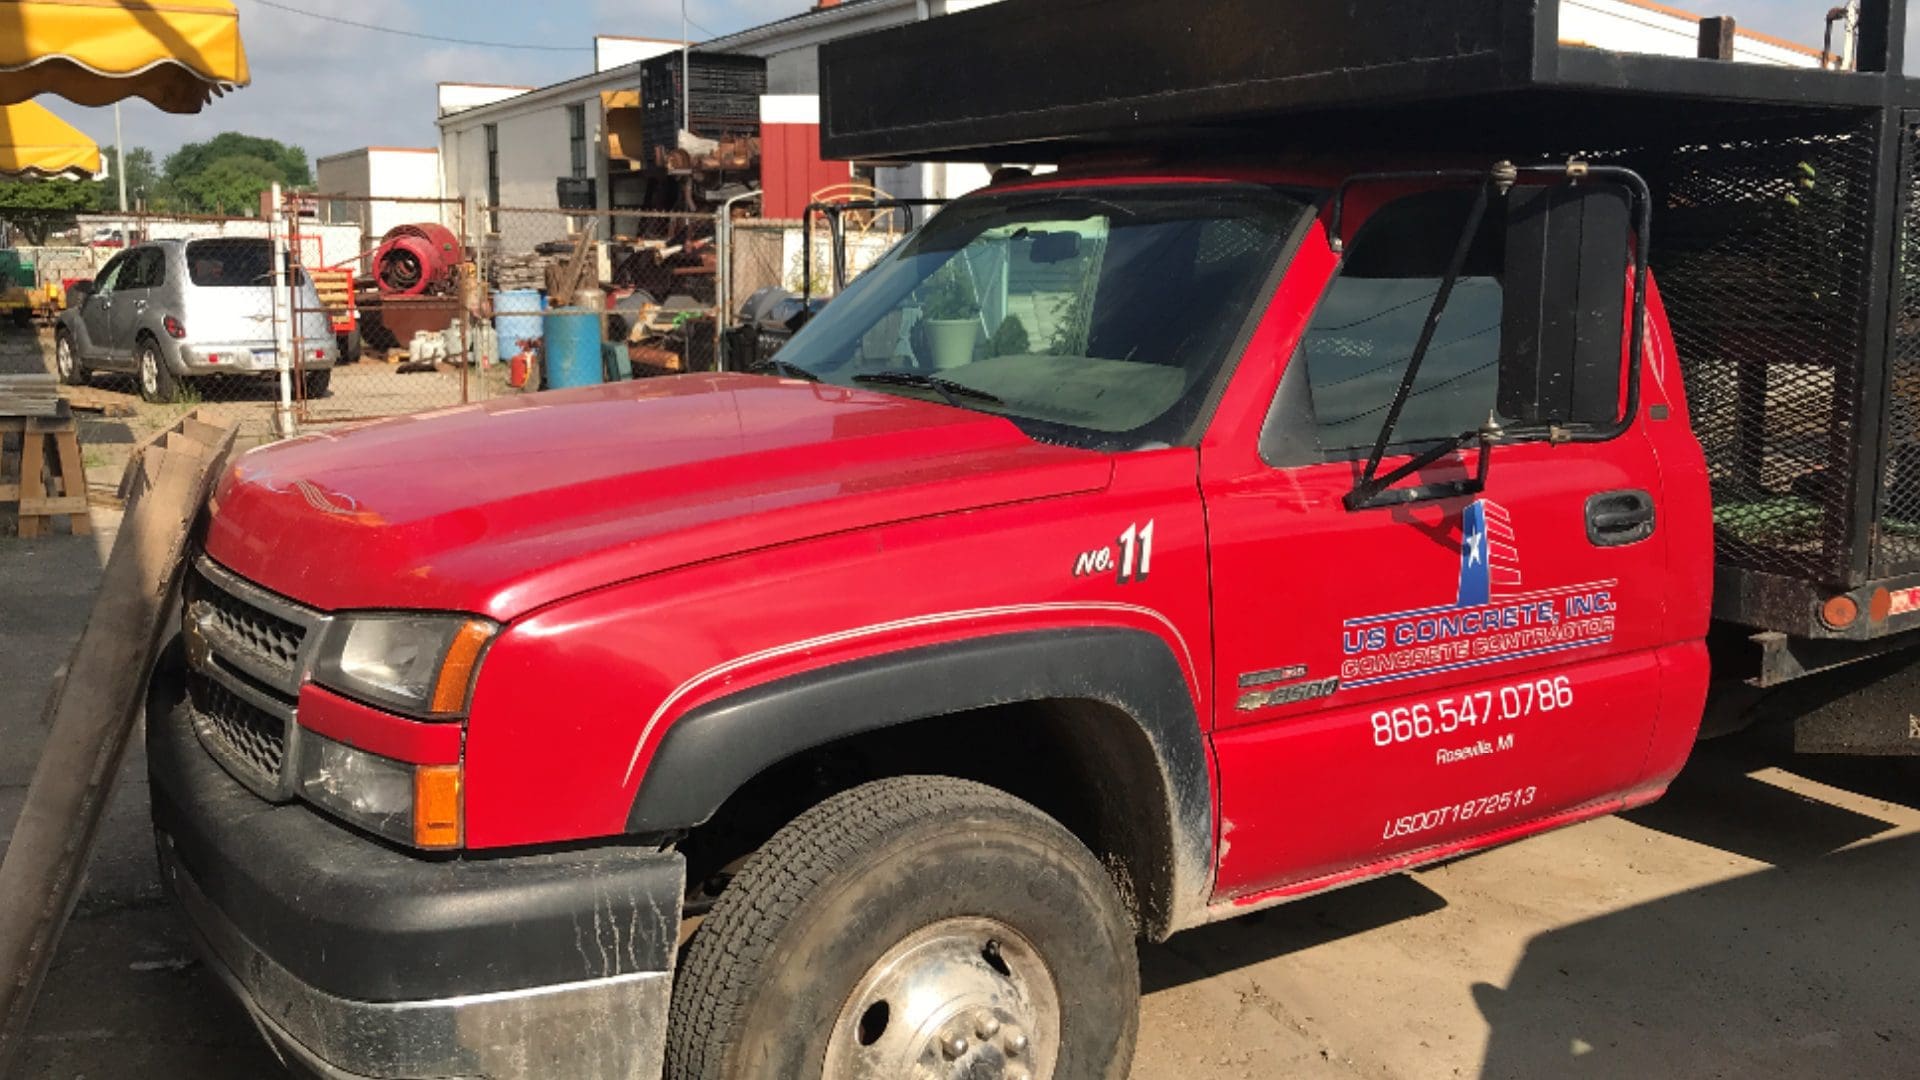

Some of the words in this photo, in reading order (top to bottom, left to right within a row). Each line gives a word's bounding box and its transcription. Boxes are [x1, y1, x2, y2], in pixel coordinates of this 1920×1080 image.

[1116, 518, 1154, 585] 11
[1341, 639, 1470, 678] CONCRETE
[1472, 616, 1615, 656] CONTRACTOR
[1343, 626, 1386, 654] US
[1394, 601, 1559, 646] CONCRETE,
[1565, 591, 1617, 618] INC.
[1371, 675, 1573, 747] 866.547.0786
[1496, 733, 1515, 751] MI
[1382, 785, 1537, 840] USDOT1872513
